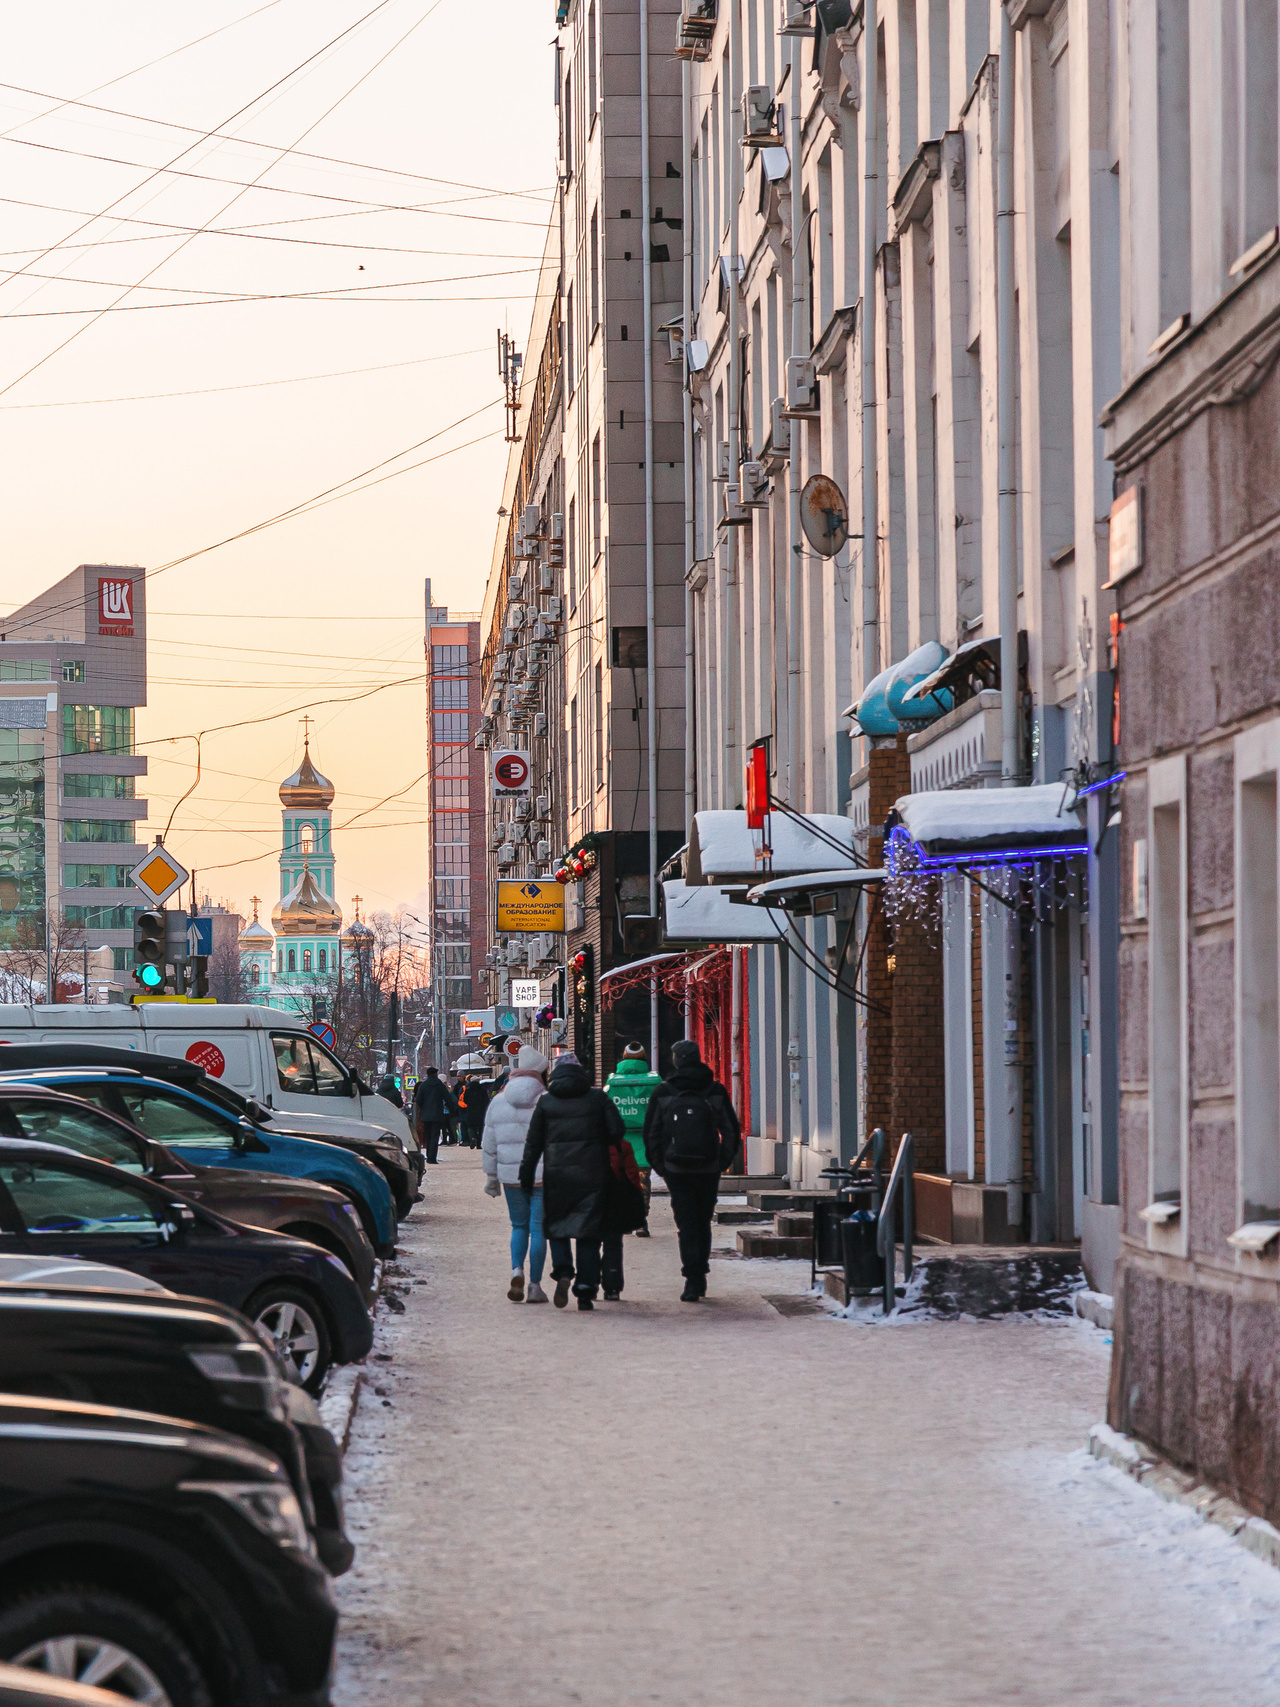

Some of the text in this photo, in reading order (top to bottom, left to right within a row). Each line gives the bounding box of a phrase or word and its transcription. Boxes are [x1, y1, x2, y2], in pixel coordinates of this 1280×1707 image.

[207, 1050, 219, 1061] 110
[211, 1056, 224, 1067] 571
[613, 1096, 650, 1105] Deliver
[617, 1106, 638, 1115] lub
